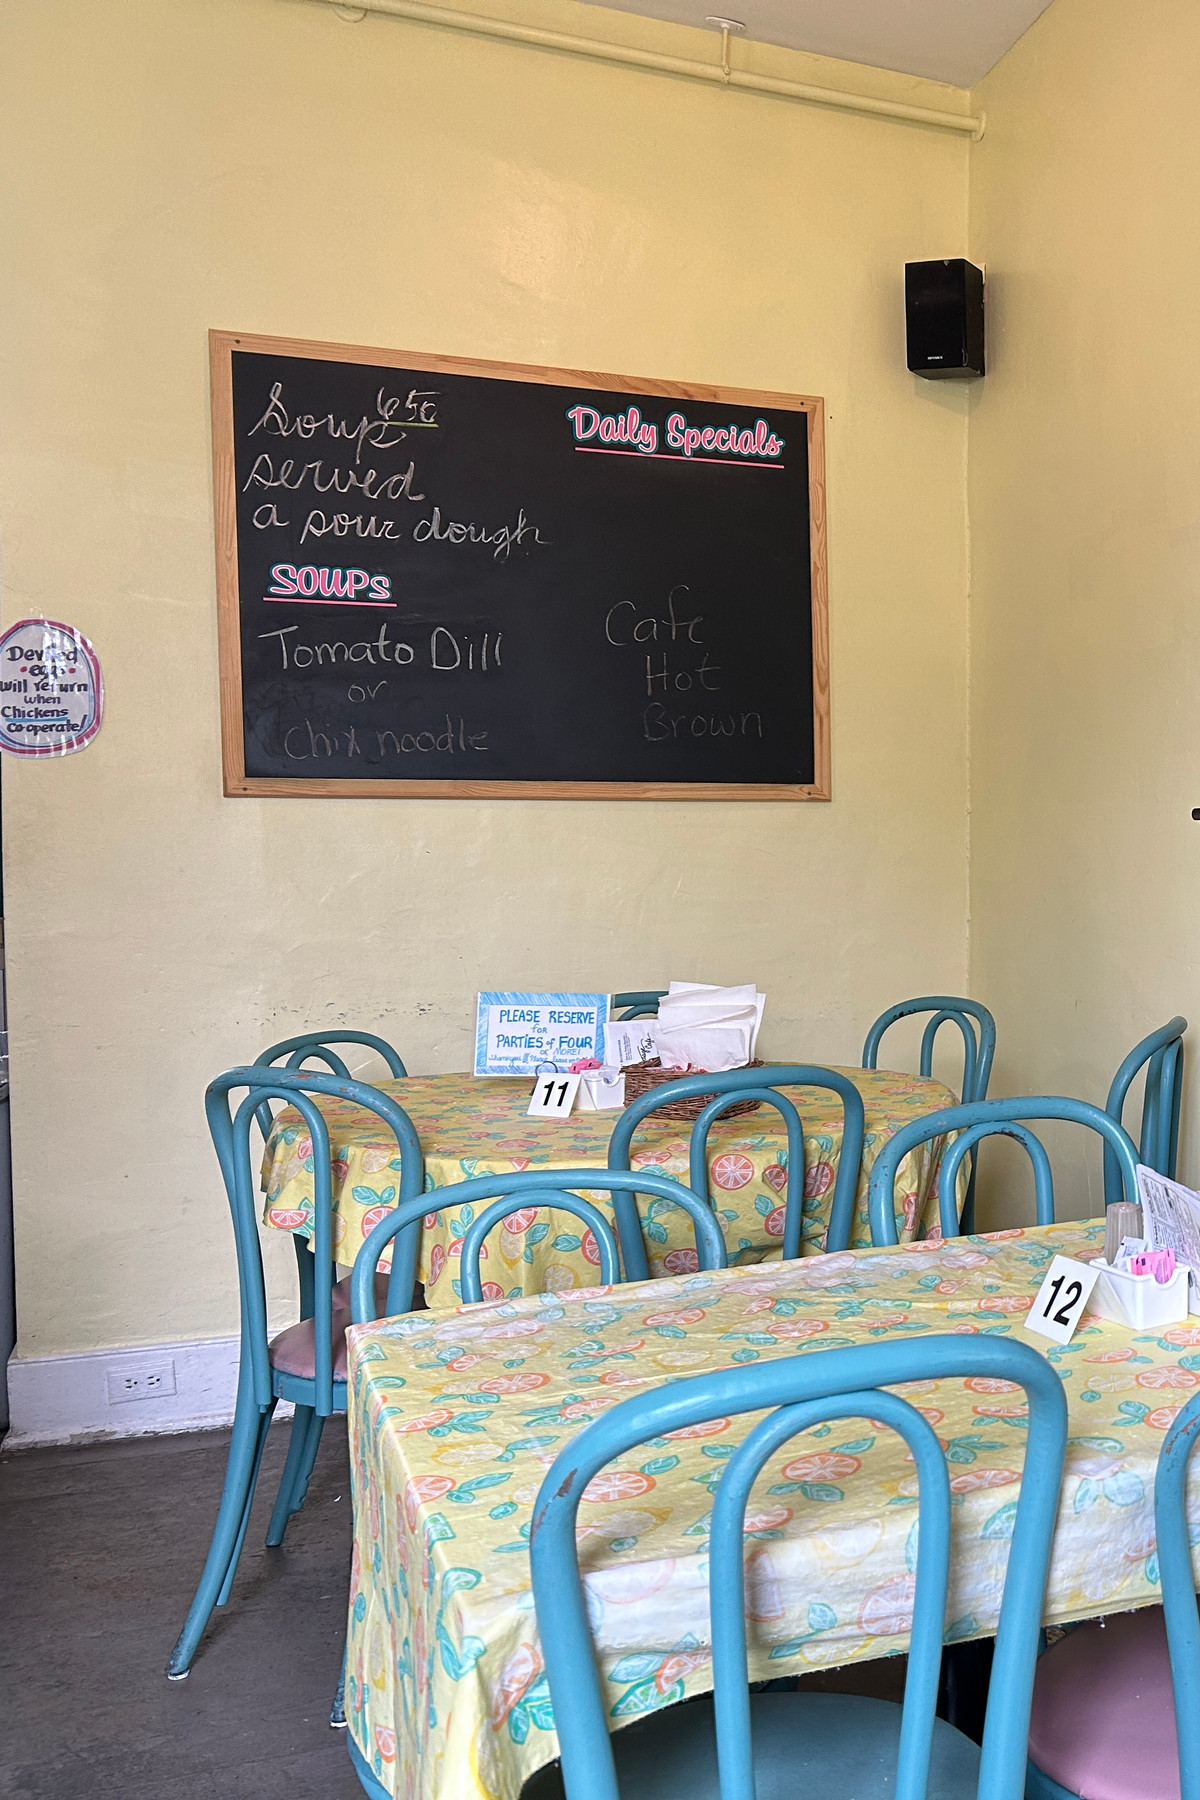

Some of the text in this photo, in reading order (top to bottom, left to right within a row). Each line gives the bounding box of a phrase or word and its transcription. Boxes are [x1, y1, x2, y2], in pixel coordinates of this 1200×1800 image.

[567, 404, 784, 457] Daily Specials
[243, 454, 425, 501] served
[300, 509, 400, 544] sour
[412, 506, 552, 562] dough
[267, 563, 393, 600] SOUPS
[605, 584, 704, 646] Cafe
[258, 623, 502, 671] Tomato Dill
[0, 679, 27, 693] will
[348, 681, 388, 703] or
[645, 652, 721, 697] Hot
[1, 706, 69, 719] Chickens
[24, 694, 62, 704] when
[377, 714, 489, 756] noodle
[642, 701, 763, 742] Brown
[499, 1009, 595, 1024] PLEASE RESERVE
[559, 1035, 593, 1049] FOUR
[543, 1080, 570, 1107] 11
[1042, 1275, 1083, 1326] 12
